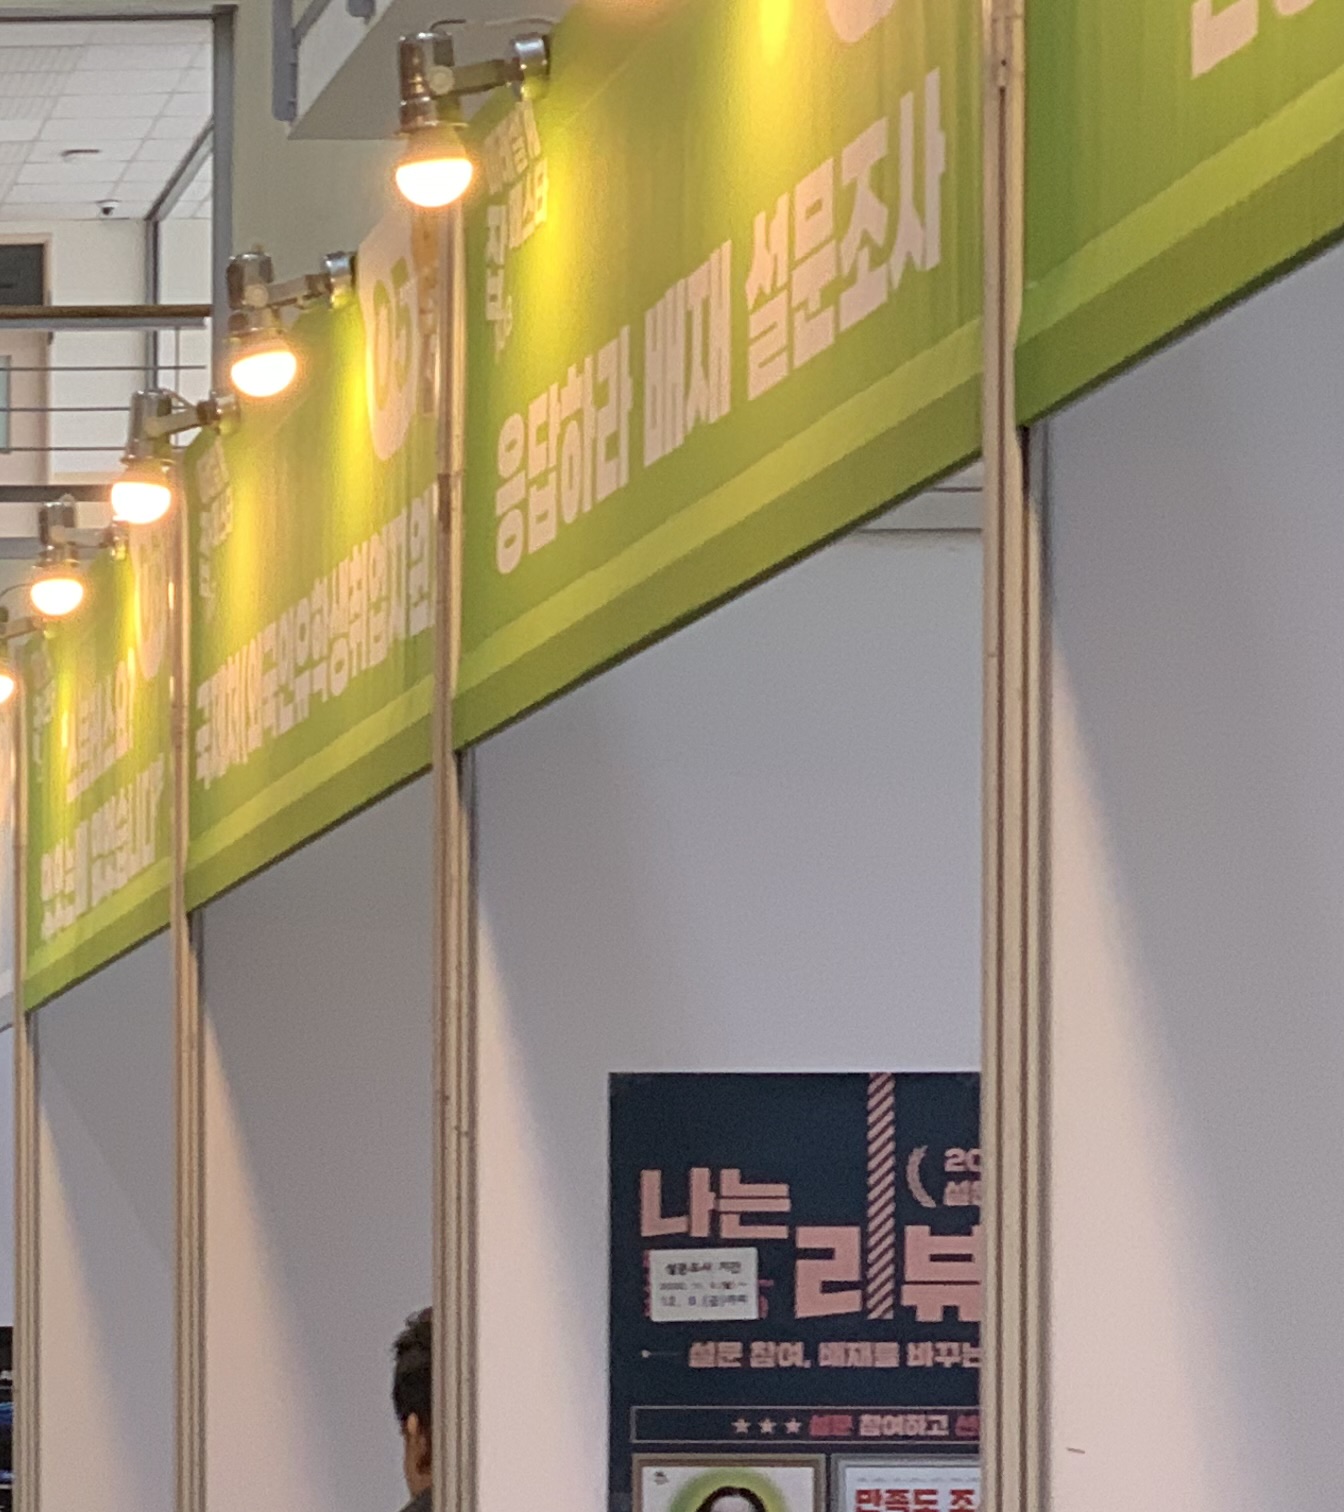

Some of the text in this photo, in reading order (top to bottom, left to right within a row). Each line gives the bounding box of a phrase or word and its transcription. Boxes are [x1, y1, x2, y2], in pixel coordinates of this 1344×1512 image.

[496, 326, 632, 575] 응답하라
[644, 240, 732, 468] 배재
[747, 68, 946, 400] 설문조사
[640, 1167, 791, 1239] 나는
